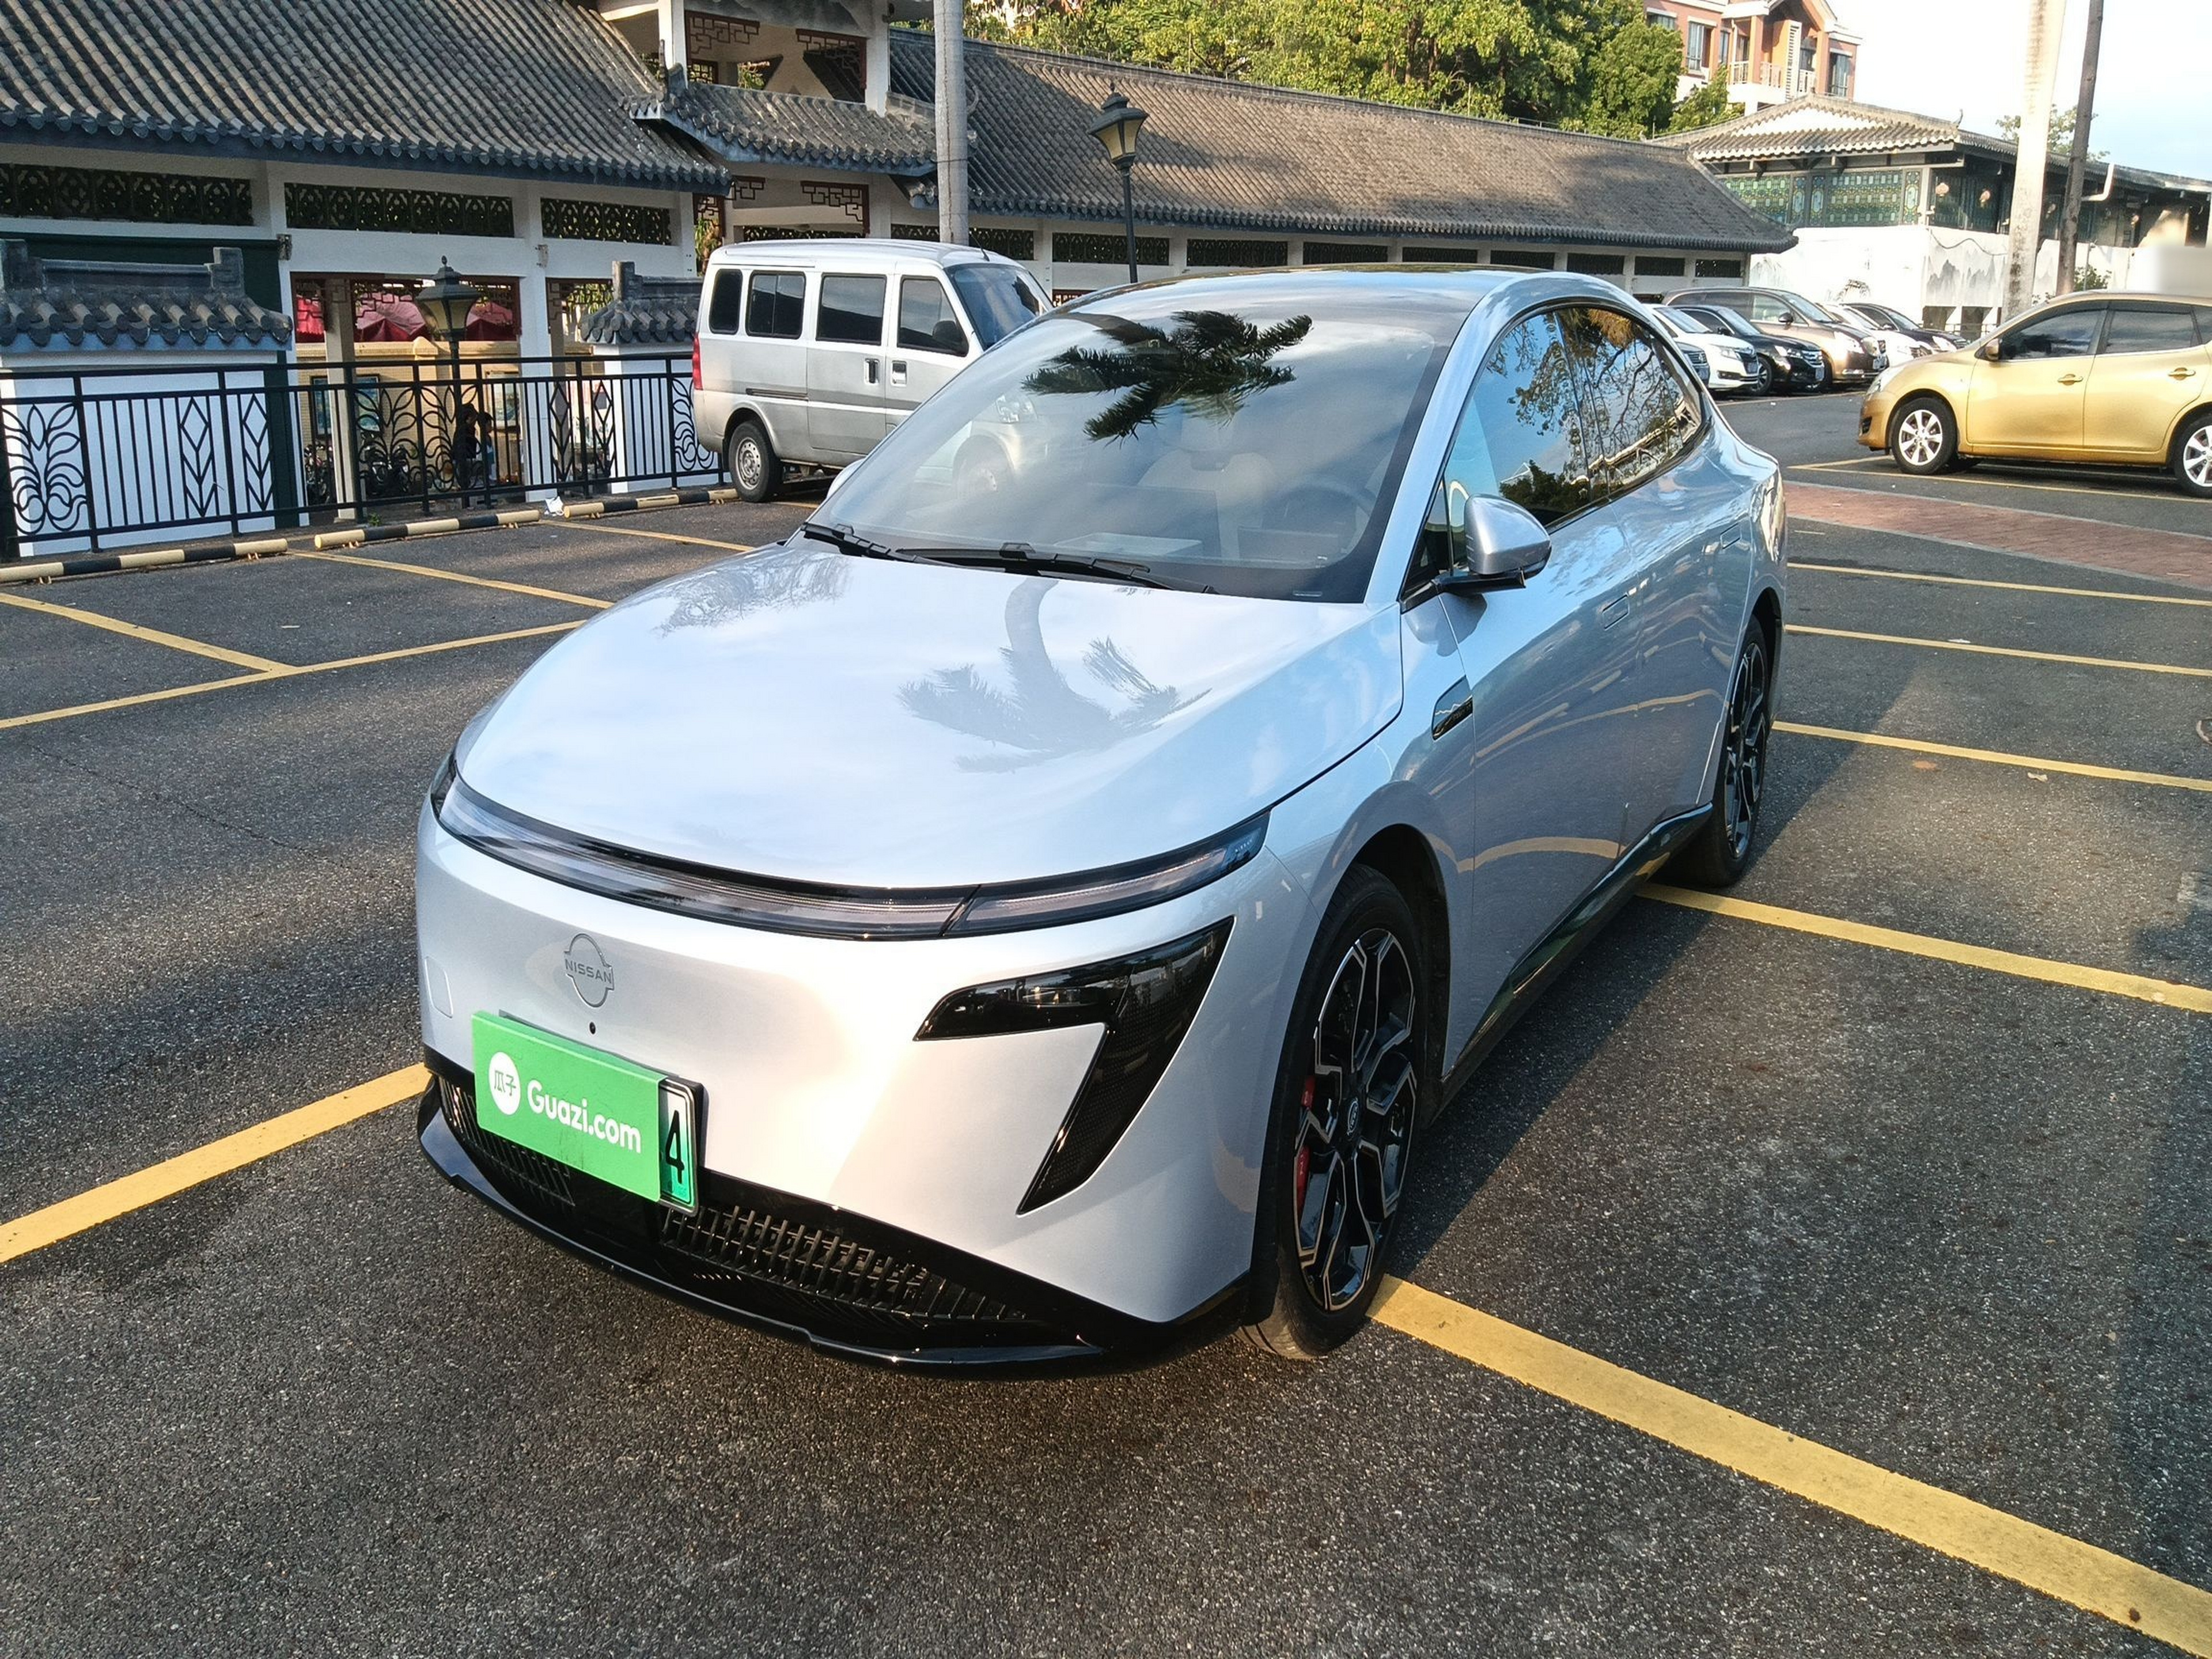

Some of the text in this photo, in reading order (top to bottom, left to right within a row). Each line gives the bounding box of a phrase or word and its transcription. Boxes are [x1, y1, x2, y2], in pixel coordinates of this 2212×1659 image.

[565, 959, 612, 984] NISSAN
[494, 1070, 516, 1096] 瓜子
[527, 1080, 641, 1153] Guazi.com
[665, 1109, 684, 1184] 4
